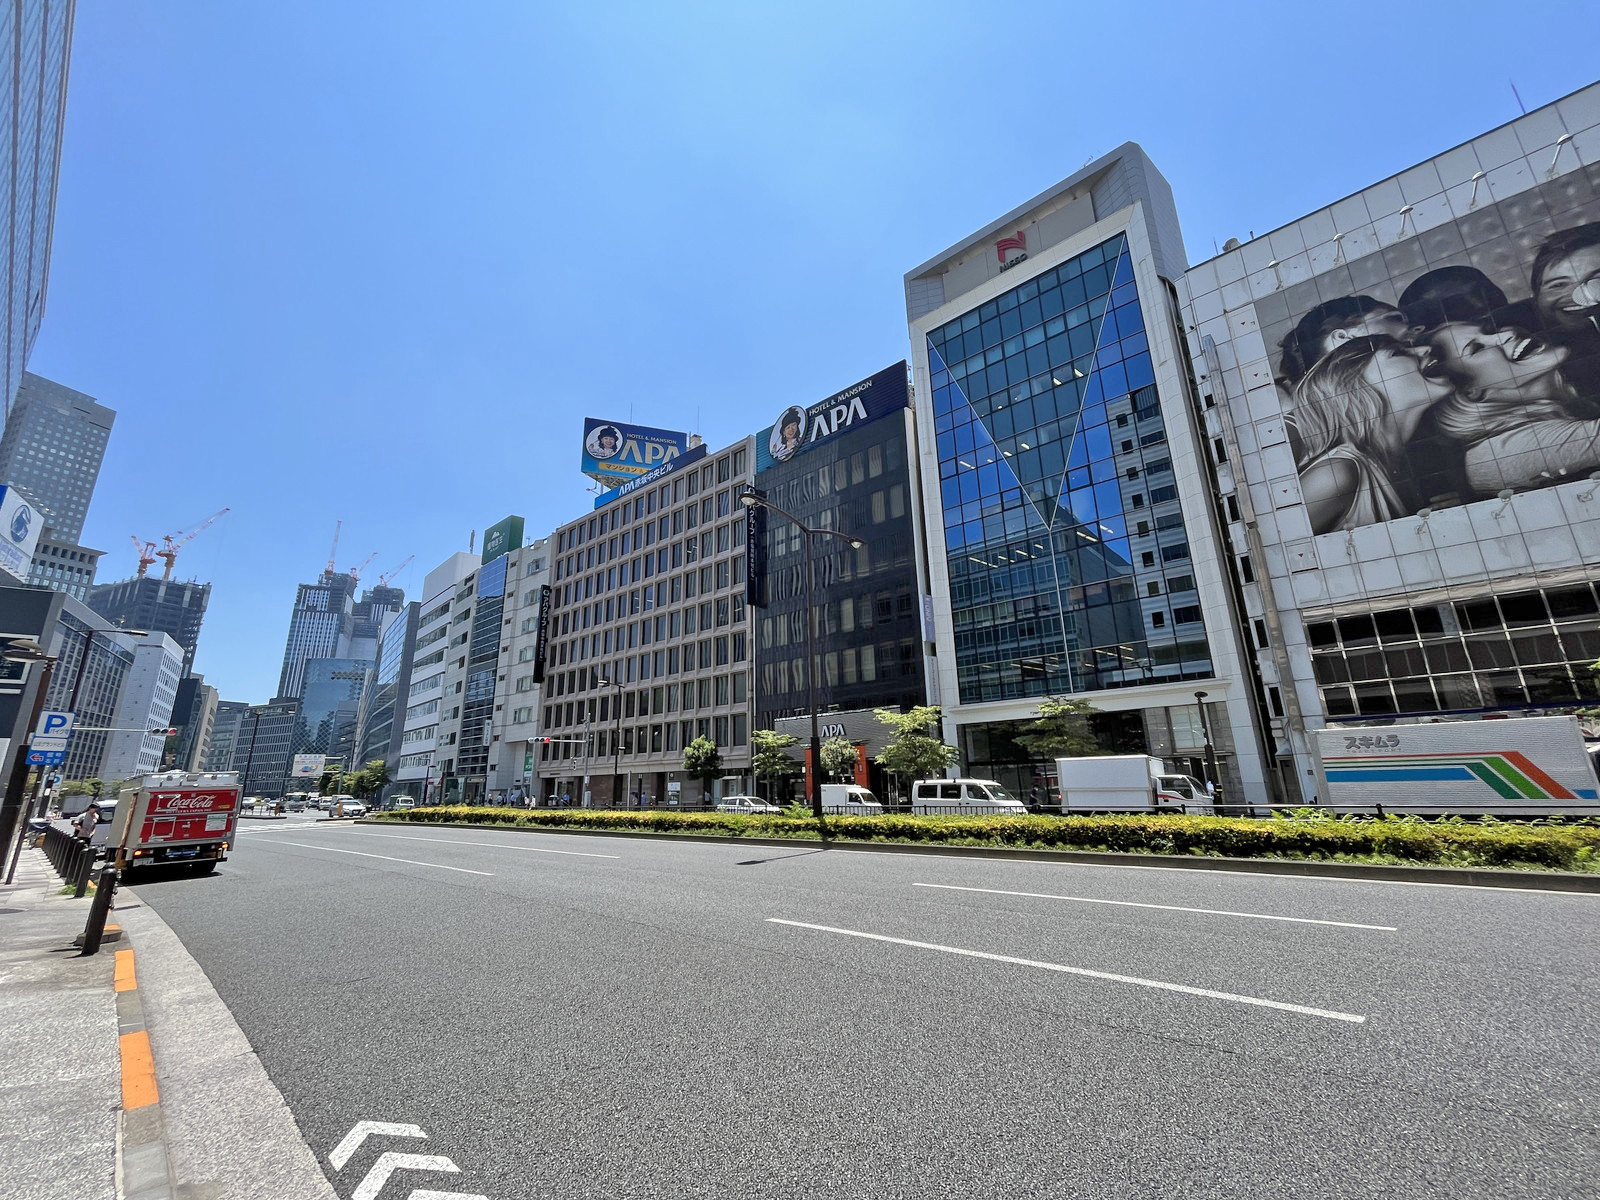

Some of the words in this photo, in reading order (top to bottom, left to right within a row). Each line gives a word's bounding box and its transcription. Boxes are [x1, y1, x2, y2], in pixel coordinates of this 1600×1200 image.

[809, 401, 830, 416] HOTEL
[837, 380, 872, 402] MANSION
[810, 396, 868, 443] APA
[650, 436, 677, 445] MANSION
[619, 439, 680, 464] APA
[44, 714, 67, 734] P
[821, 723, 846, 737] APA
[1343, 735, 1400, 749] スキムラ
